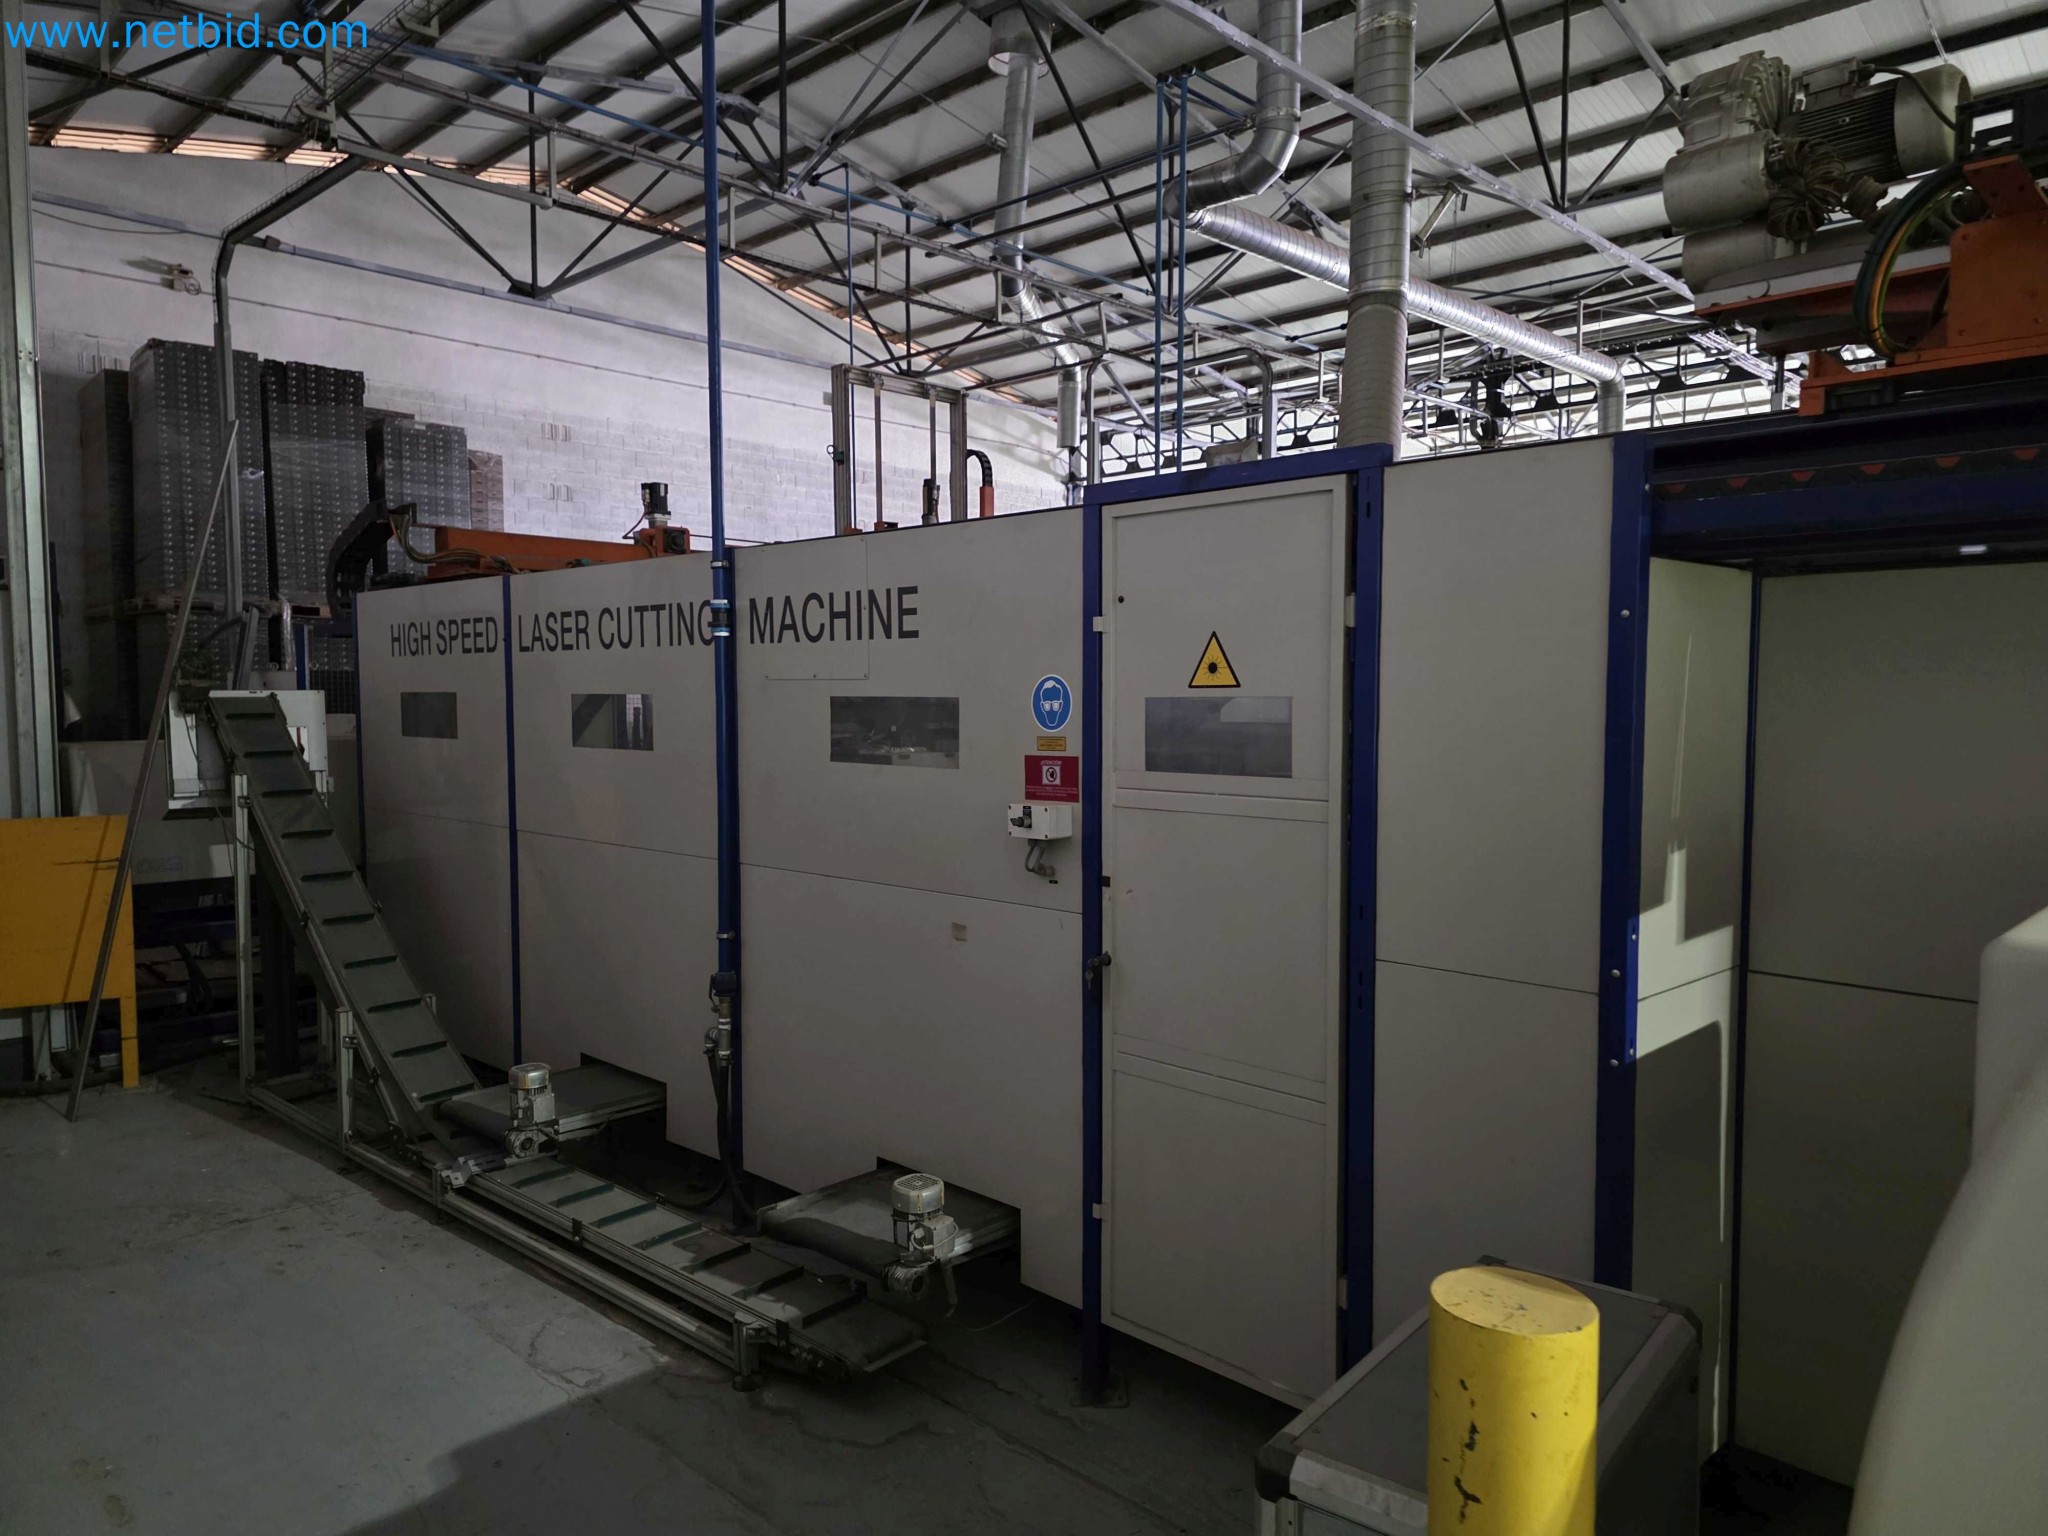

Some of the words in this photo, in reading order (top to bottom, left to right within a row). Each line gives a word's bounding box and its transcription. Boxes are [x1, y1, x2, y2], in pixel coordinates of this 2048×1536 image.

[391, 621, 431, 657] HIGH
[436, 616, 498, 655] SPEED
[518, 611, 590, 652] LASER
[749, 585, 919, 644] MACHINE
